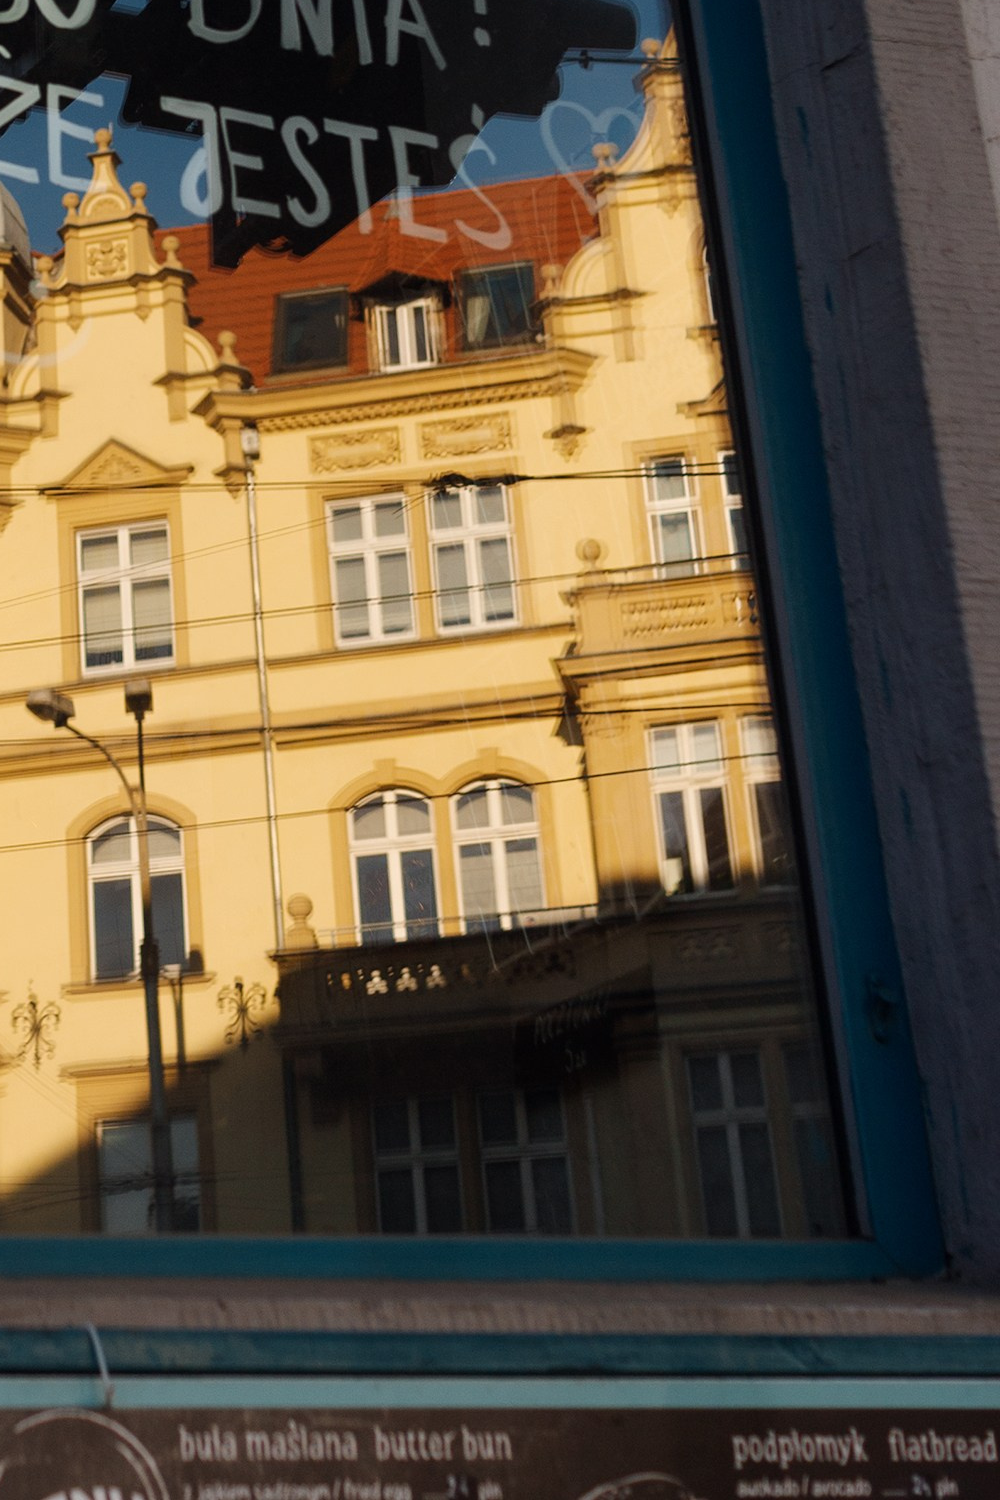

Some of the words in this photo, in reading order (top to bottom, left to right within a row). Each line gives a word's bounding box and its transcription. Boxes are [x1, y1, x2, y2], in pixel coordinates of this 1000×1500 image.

[179, 95, 512, 251] JESTEŚ
[373, 1422, 456, 1463] butter
[461, 1423, 514, 1462] bun
[887, 1426, 1000, 1464] flatbread
